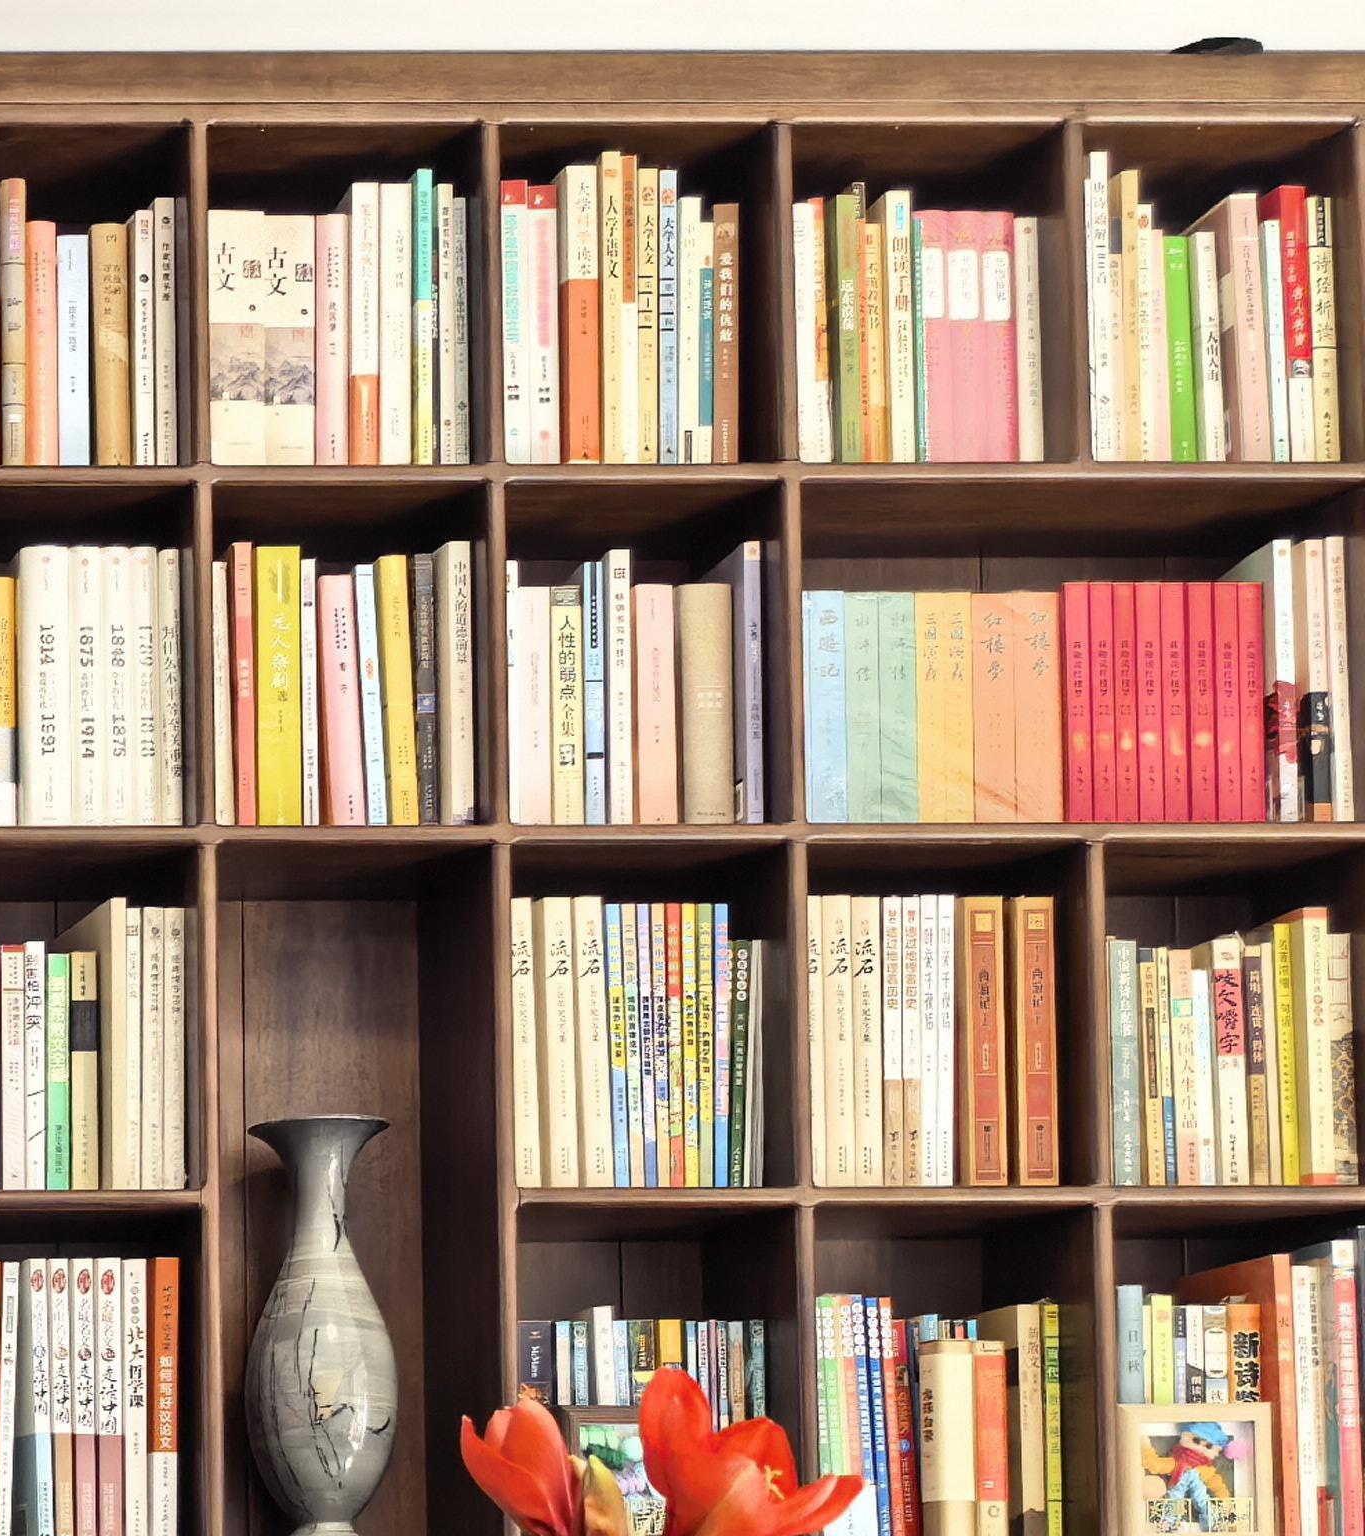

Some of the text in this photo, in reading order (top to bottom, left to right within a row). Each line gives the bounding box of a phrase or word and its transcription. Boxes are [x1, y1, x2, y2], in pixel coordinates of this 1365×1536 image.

[891, 236, 910, 313] 朗读手册
[559, 614, 576, 738] 人性的弱点全集
[126, 1327, 145, 1409] 北大哲学课
